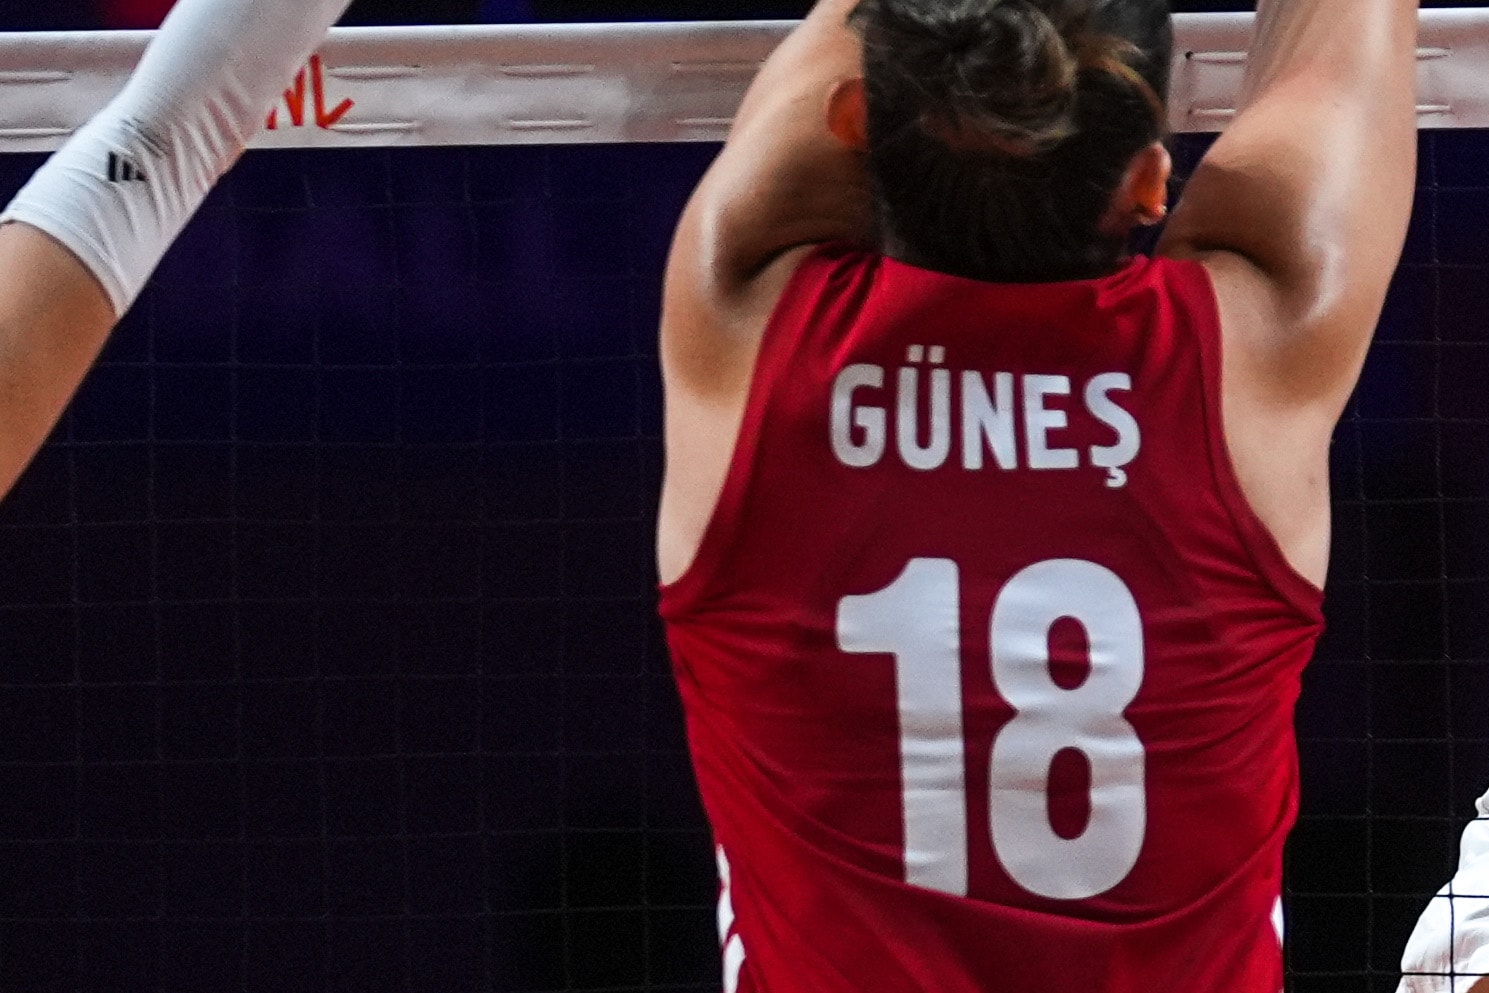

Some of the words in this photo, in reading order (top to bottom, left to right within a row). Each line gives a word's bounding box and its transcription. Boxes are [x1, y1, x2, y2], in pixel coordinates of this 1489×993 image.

[265, 54, 355, 131] NL
[828, 344, 1142, 488] GÜNEŞ
[835, 557, 1146, 899] 18
